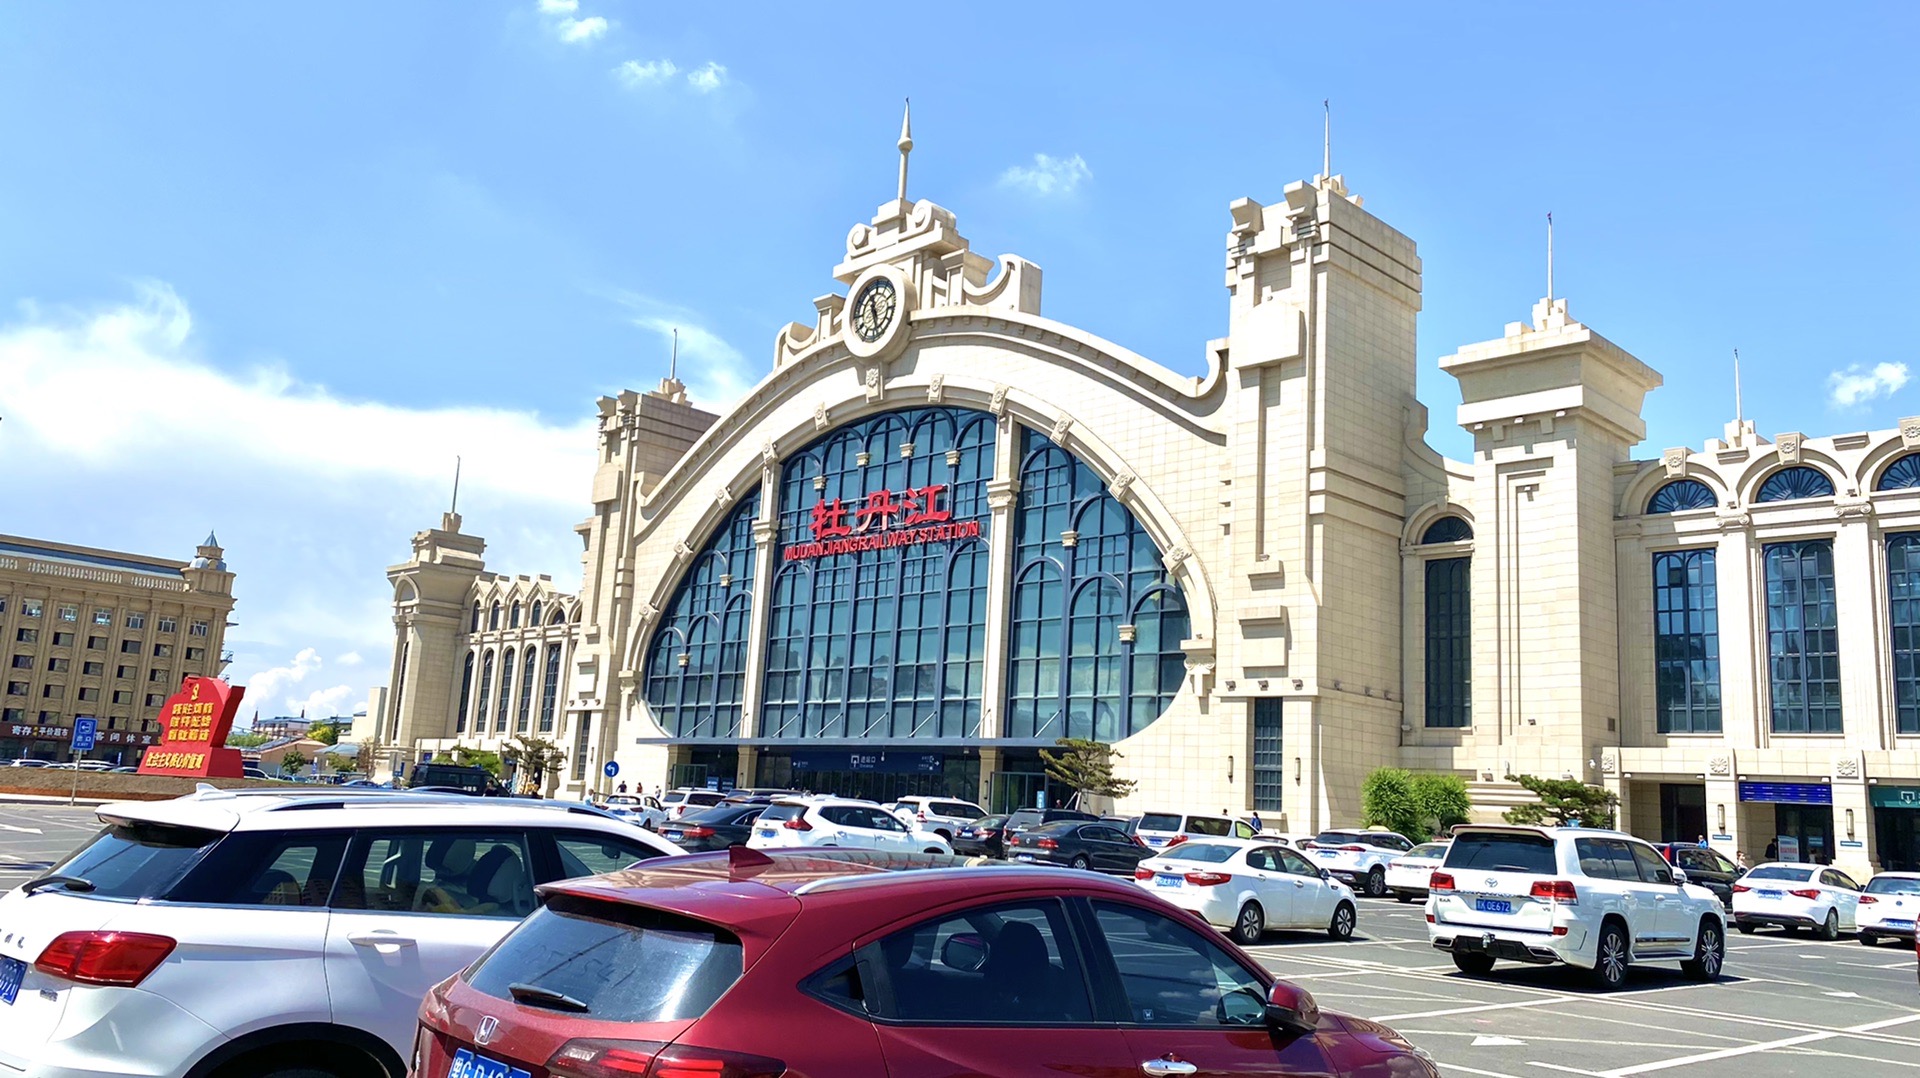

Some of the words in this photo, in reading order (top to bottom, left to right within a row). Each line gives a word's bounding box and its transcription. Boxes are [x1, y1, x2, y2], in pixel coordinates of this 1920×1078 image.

[809, 484, 950, 541] 牡丹江
[783, 538, 859, 560] MUDANJIANG
[859, 530, 916, 551] RAILWAY
[919, 520, 980, 543] STATION
